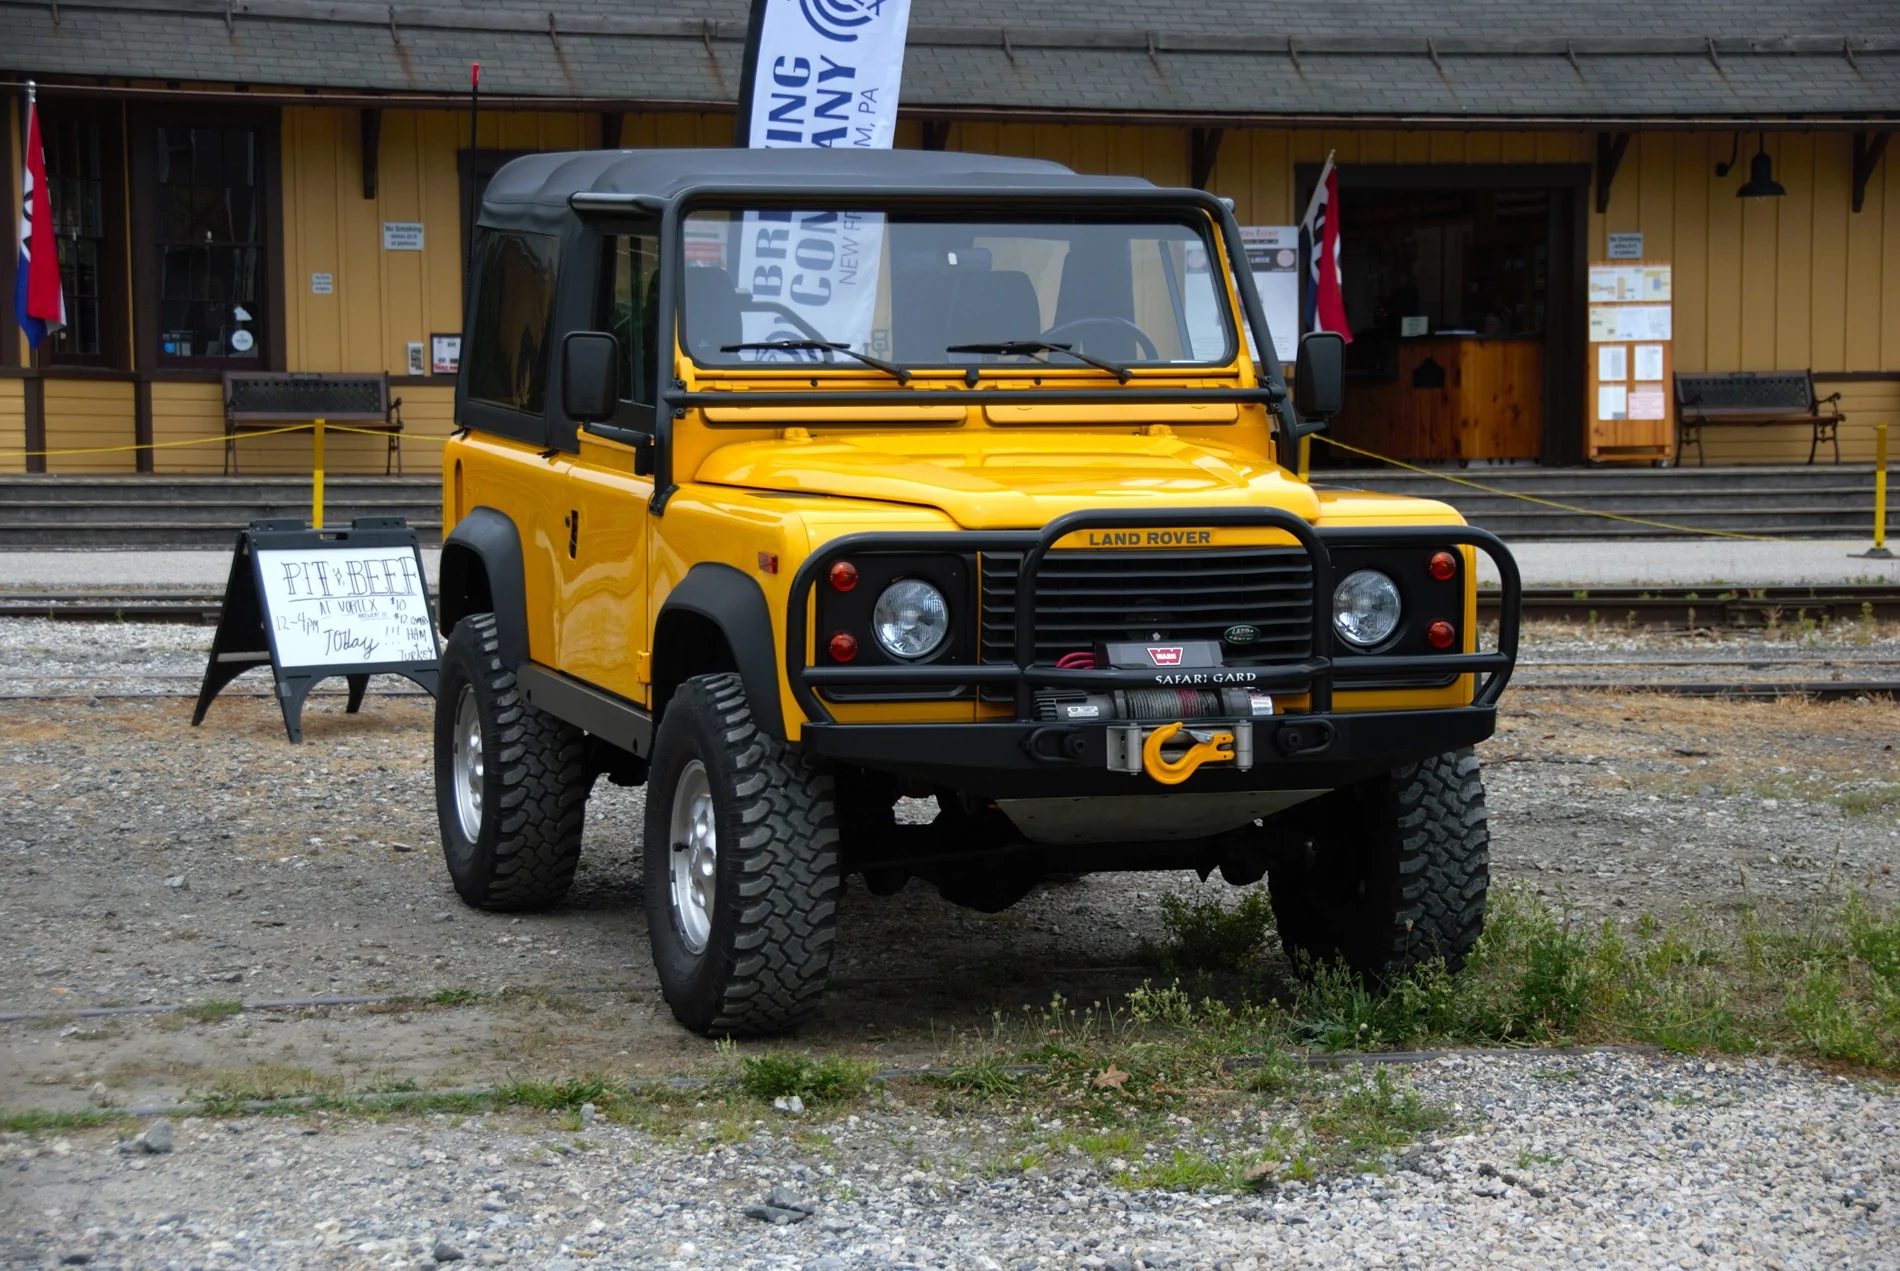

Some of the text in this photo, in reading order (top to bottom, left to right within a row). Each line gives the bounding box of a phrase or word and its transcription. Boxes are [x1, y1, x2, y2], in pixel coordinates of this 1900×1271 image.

[838, 236, 860, 285] NEW
[858, 87, 879, 115] PA
[1089, 531, 1211, 546] LAND ROVER
[280, 556, 417, 596] PIT BEEF
[319, 598, 379, 616] AT VORTEX
[390, 596, 407, 611] $10
[407, 627, 427, 643] HAM
[398, 646, 434, 661] TURKEY
[1155, 672, 1256, 685] SAFARI GARD
